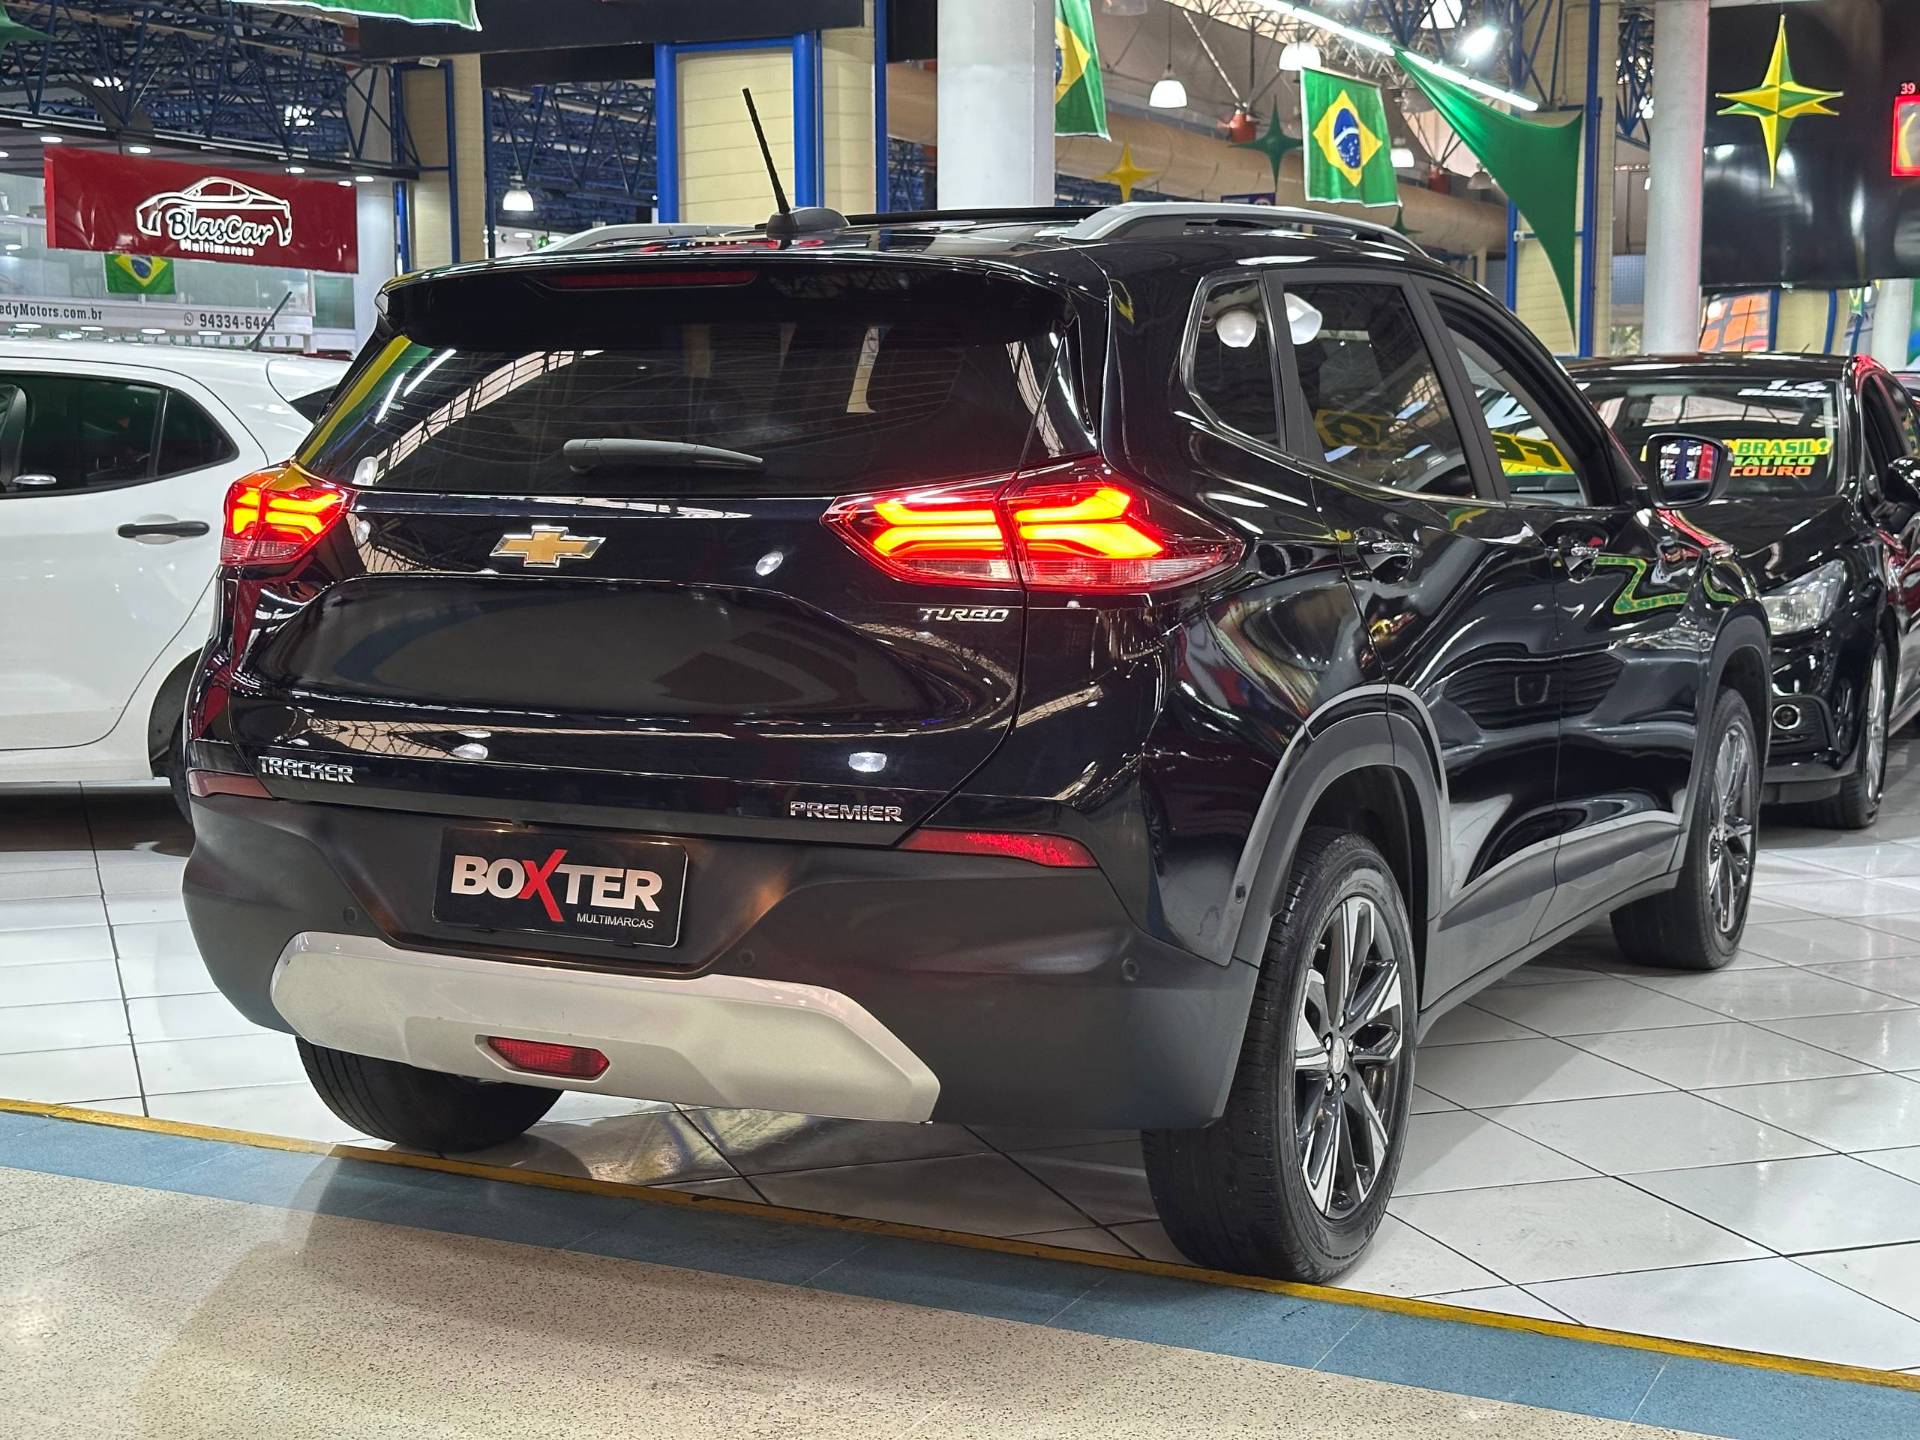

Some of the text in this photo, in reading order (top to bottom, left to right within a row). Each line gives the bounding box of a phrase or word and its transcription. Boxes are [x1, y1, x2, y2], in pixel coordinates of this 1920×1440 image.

[1901, 82, 1916, 94] 39
[166, 207, 274, 247] BlasCar
[1729, 466, 1813, 477] COURO
[919, 608, 1010, 622] TURBO
[257, 755, 355, 784] TRACKER
[789, 801, 903, 822] PREMIER
[450, 848, 664, 923] BOXTER
[576, 912, 655, 930] MULTIMARCAS
